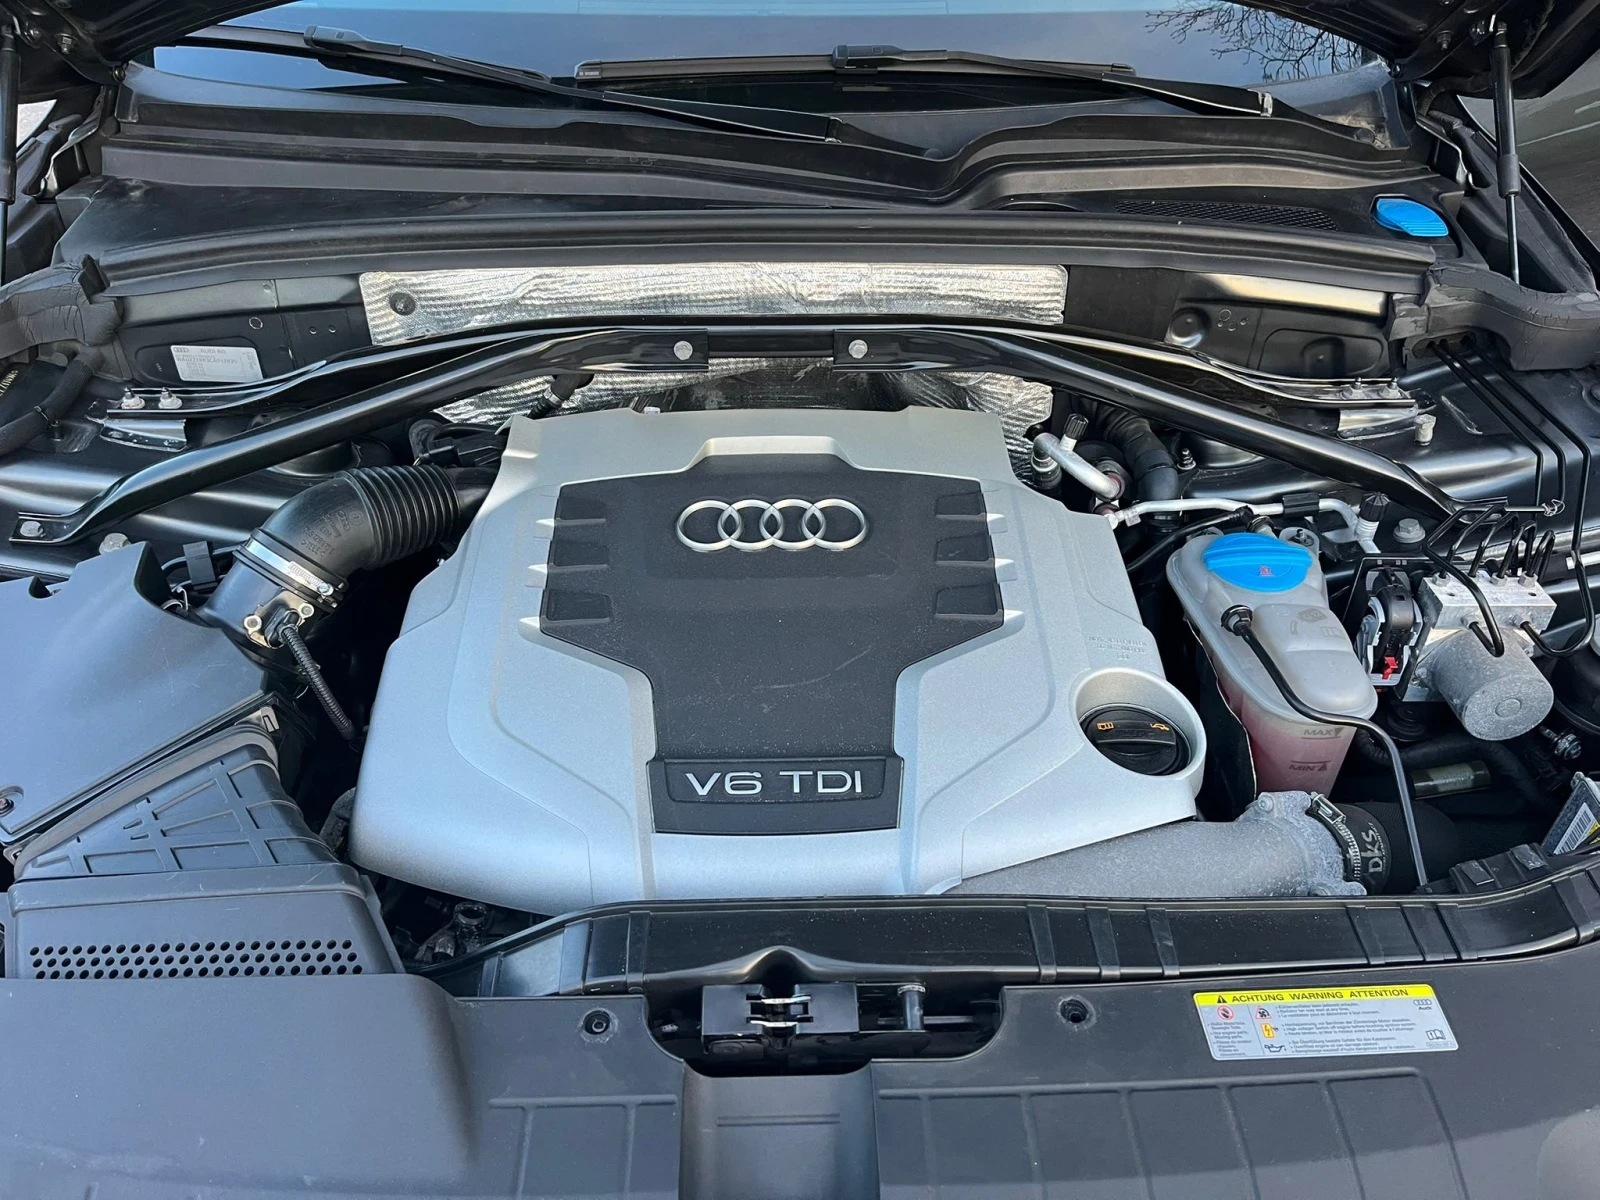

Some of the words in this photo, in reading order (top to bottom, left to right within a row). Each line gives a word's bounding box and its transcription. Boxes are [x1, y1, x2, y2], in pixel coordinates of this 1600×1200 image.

[1303, 728, 1333, 736] MAX
[1288, 763, 1316, 772] MIN
[685, 771, 762, 796] V6
[779, 770, 862, 794] TDI
[1231, 993, 1285, 1003] ACHTUNG
[1289, 991, 1344, 1001] WARNING
[1349, 988, 1409, 999] ATTENTION
